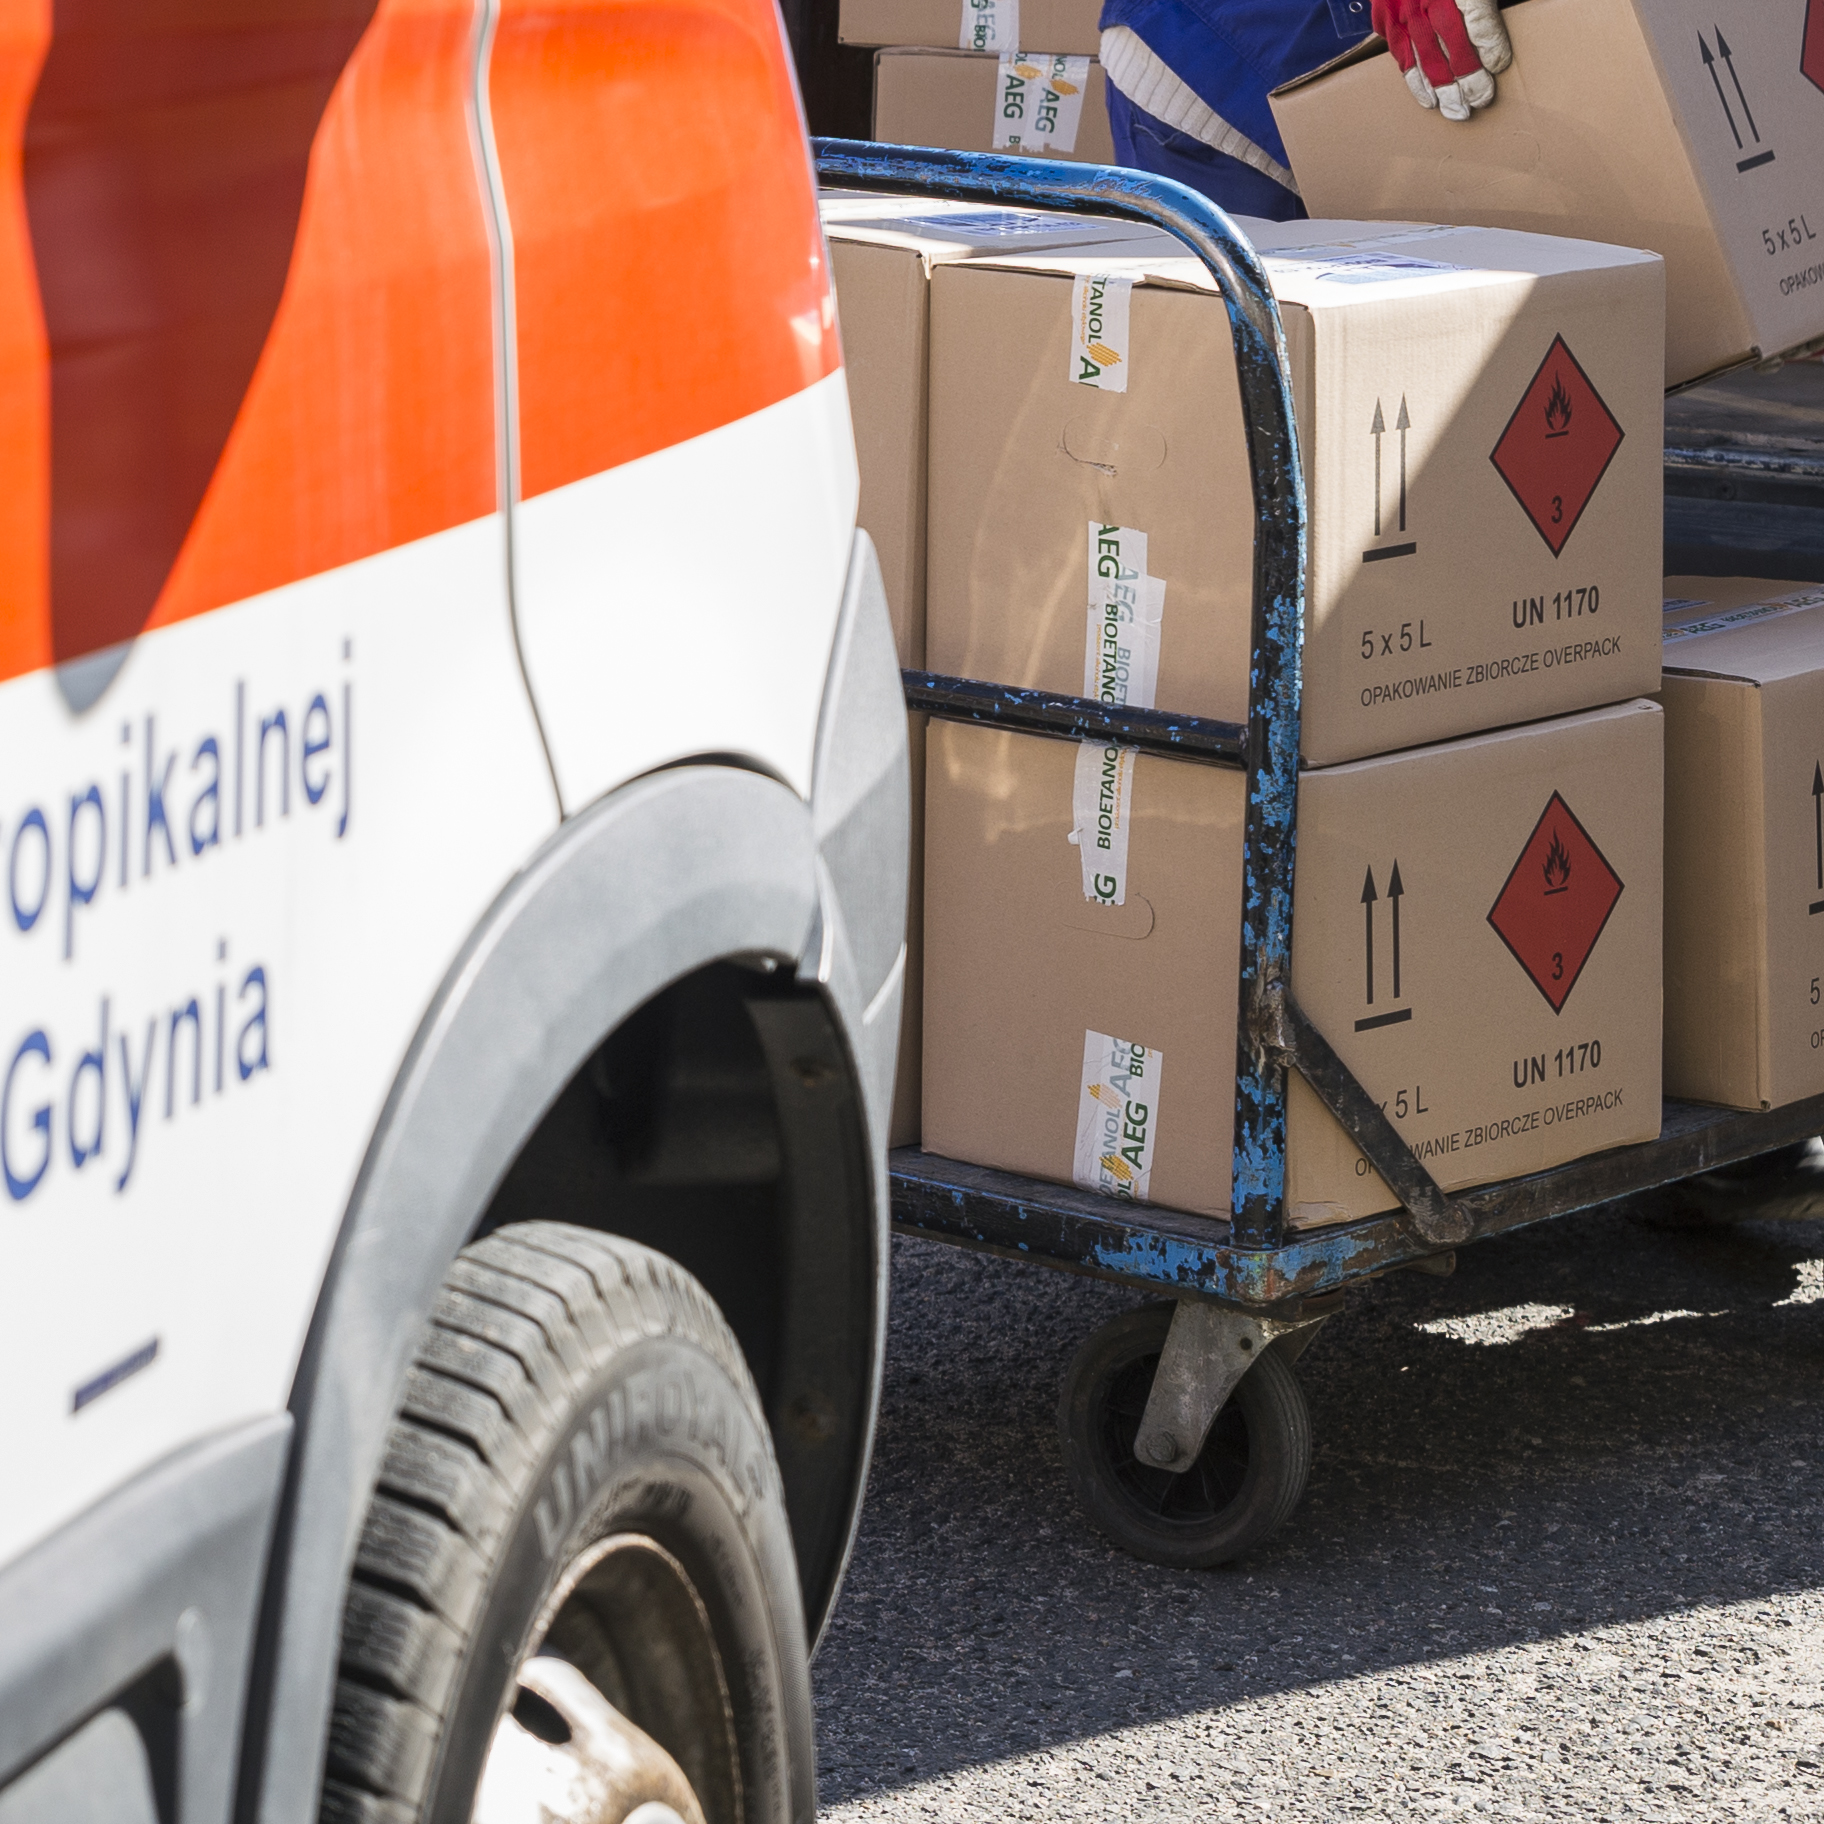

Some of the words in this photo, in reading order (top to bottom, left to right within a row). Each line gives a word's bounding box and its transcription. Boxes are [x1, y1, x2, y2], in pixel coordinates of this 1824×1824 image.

[1003, 74, 1025, 119] AEG
[1035, 87, 1060, 134] AEG
[1762, 229, 1776, 255] 5
[1788, 218, 1802, 245] 5
[1801, 214, 1817, 240] L
[1088, 275, 1107, 344] TANOL
[1551, 495, 1563, 524] 3
[1512, 595, 1544, 629] UN
[1552, 585, 1600, 621] 1170
[1101, 603, 1119, 705] BIOETANO
[1361, 630, 1374, 660] 5
[1399, 622, 1413, 652] 5
[1419, 619, 1432, 648] L
[1360, 668, 1462, 707] OPAKOWANIE
[1465, 652, 1539, 685] ZBIORCZE
[1543, 635, 1622, 668] OVERPACK
[1097, 743, 1119, 850] BIOETANO
[1551, 951, 1564, 980] 3
[1810, 977, 1820, 1005] 5
[1513, 1053, 1546, 1088] UN
[1554, 1039, 1601, 1077] 1170
[1395, 1089, 1408, 1119] 5
[1416, 1085, 1428, 1114] L
[1464, 1110, 1540, 1149] ZBIORCZE
[1543, 1088, 1623, 1126] OVERPACK
[1121, 1100, 1148, 1170] AEG
